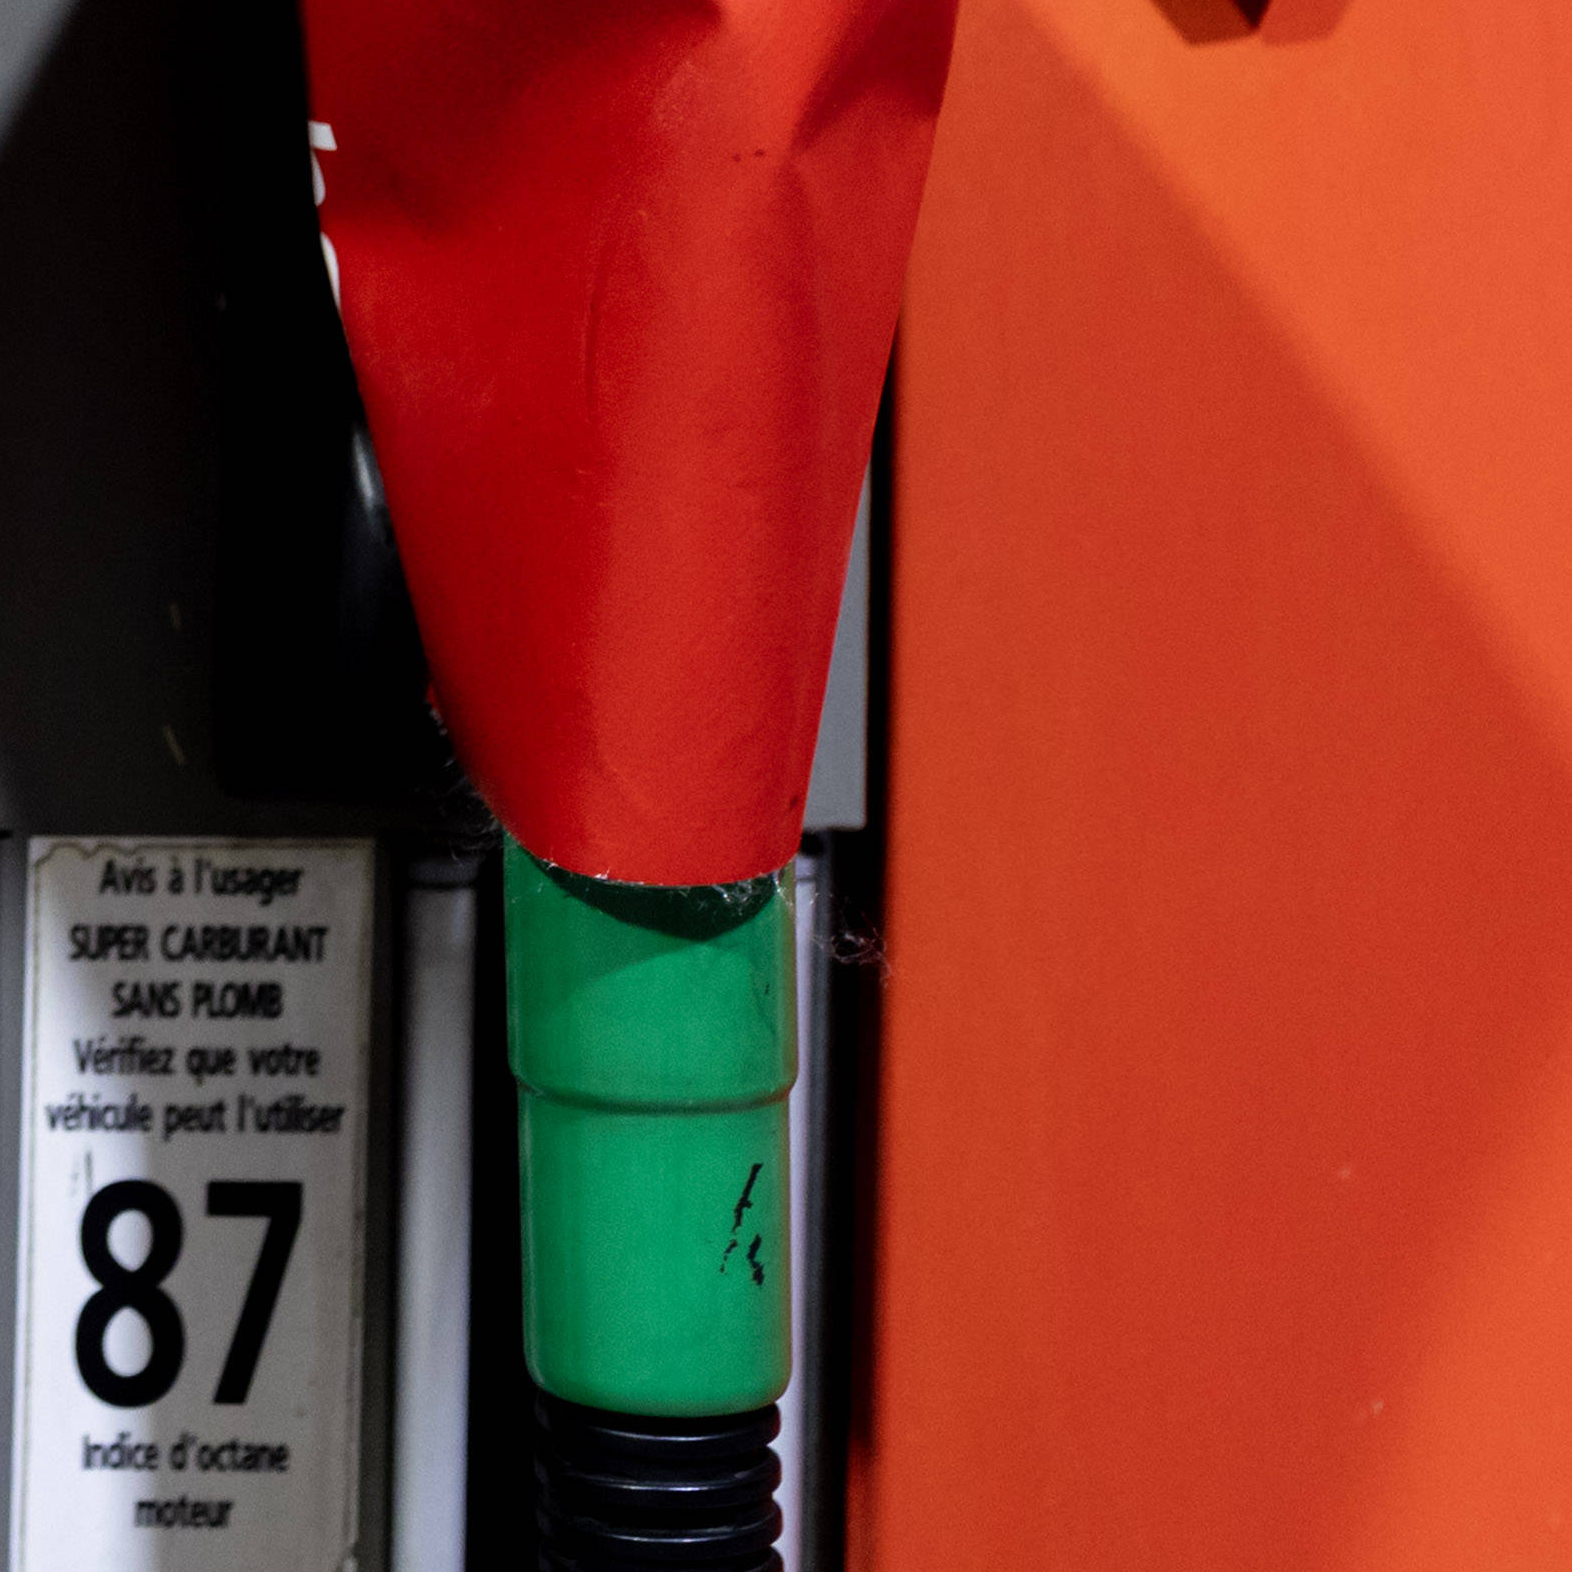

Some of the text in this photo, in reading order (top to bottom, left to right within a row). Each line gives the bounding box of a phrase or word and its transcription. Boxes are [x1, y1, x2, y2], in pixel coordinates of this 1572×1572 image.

[100, 857, 303, 905] Avis à l'usager
[69, 924, 328, 961] SUPER CARBURANT
[112, 981, 284, 1018] SANS PLOMB
[74, 1036, 320, 1085] Vérifiez que votre
[45, 1093, 345, 1141] véhicule peut l'utiliser
[75, 1179, 304, 1408] 87
[82, 1431, 289, 1472] Indice d'octane
[134, 1495, 233, 1528] moteur
